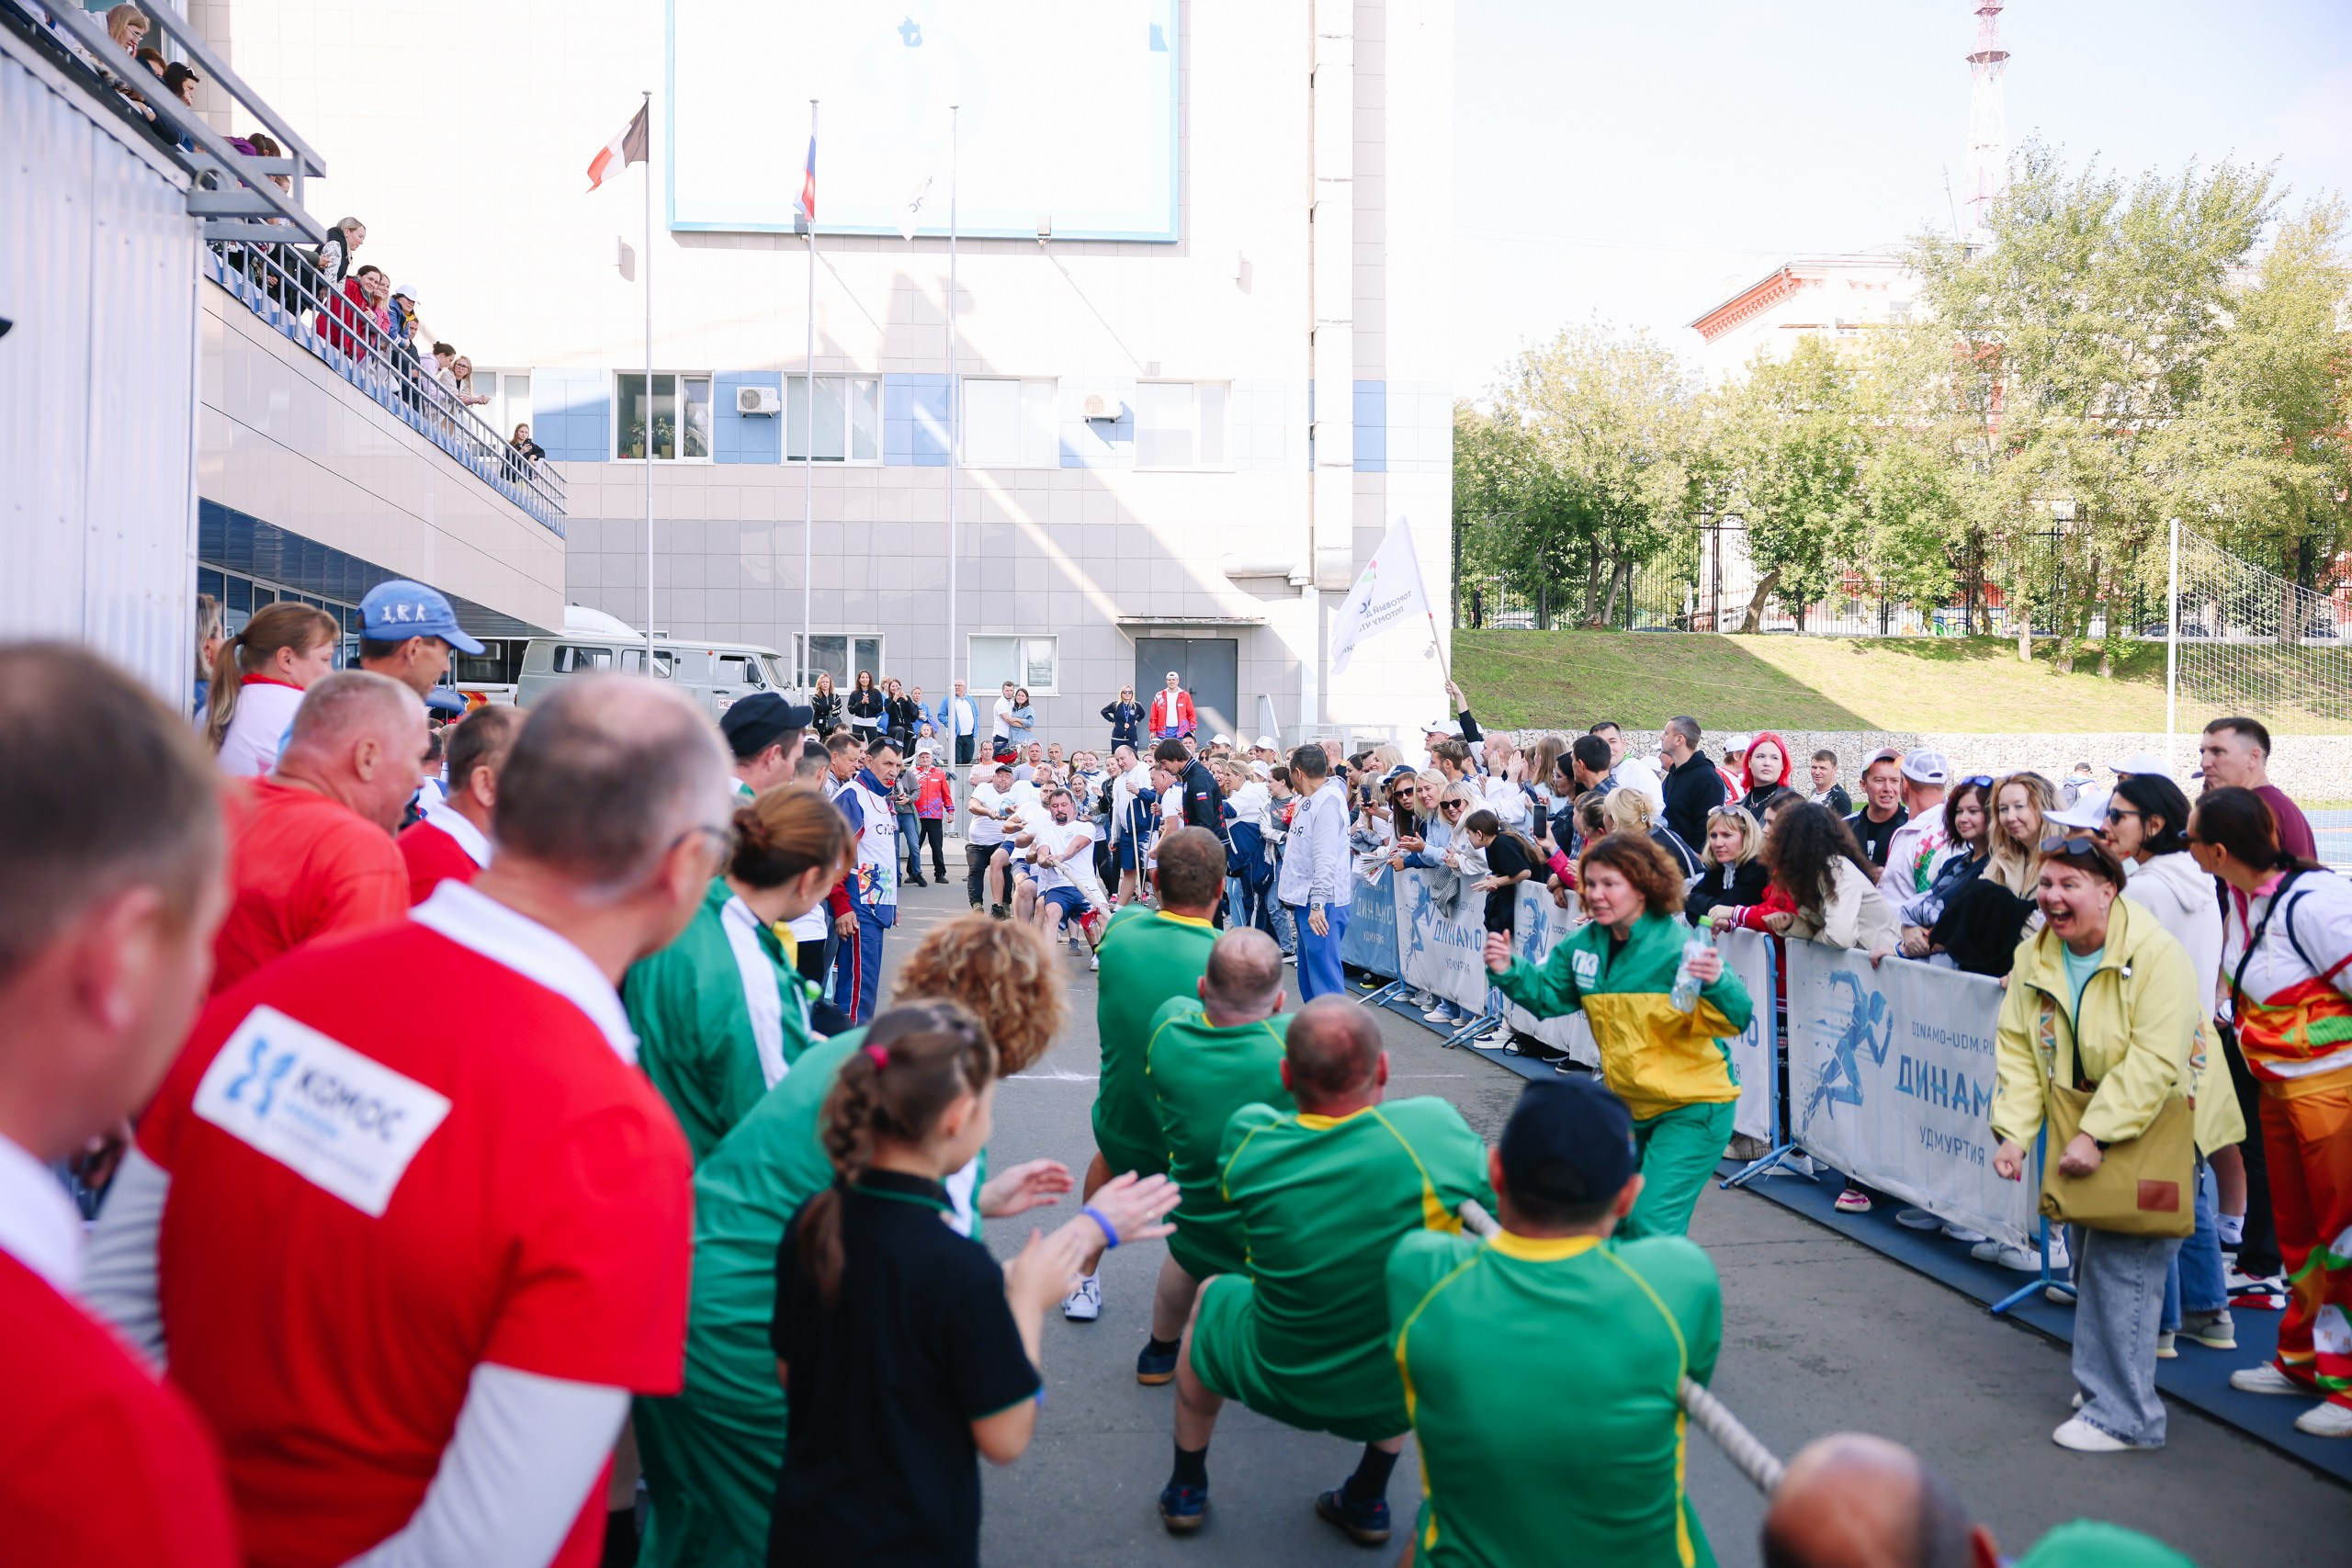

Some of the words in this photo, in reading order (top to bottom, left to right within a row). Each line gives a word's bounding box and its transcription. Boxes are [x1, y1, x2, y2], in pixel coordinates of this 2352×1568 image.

[1432, 919, 1482, 953] ДИНАМО
[1912, 1021, 1996, 1056] DINAMO-UDM.RU
[295, 1064, 406, 1143] КОМОС
[1894, 1054, 1995, 1122] ДИНАМ
[1919, 1125, 1985, 1168] УДМУРТИЯ
